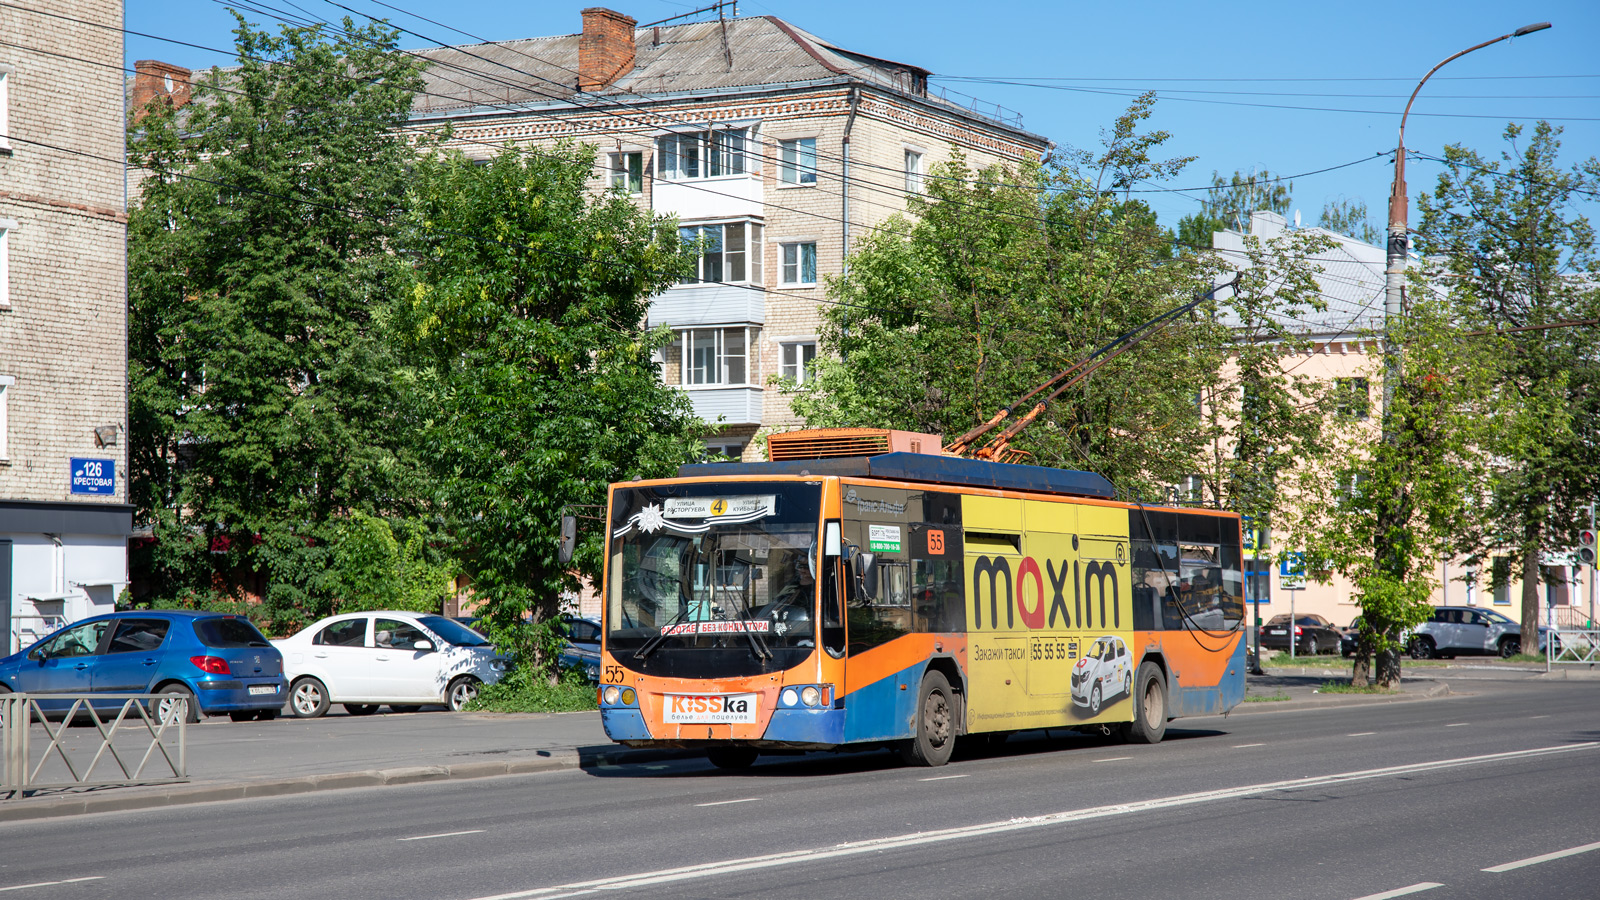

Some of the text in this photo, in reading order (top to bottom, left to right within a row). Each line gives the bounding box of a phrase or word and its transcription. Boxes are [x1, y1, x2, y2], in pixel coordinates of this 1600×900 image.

[83, 461, 102, 477] 126
[73, 477, 112, 486] КРЕСТОВАЯ
[713, 499, 723, 514] 4
[930, 534, 943, 550] 55
[973, 534, 1120, 630] maxim
[661, 621, 768, 636] РАБОТАЕ БЕЗ КОНДУТОРА
[974, 644, 1003, 661] Закажи
[1004, 648, 1025, 660] такси
[1033, 643, 1042, 660] 55
[1044, 643, 1054, 660] 55
[1056, 643, 1065, 660] 55
[605, 665, 624, 683] 55
